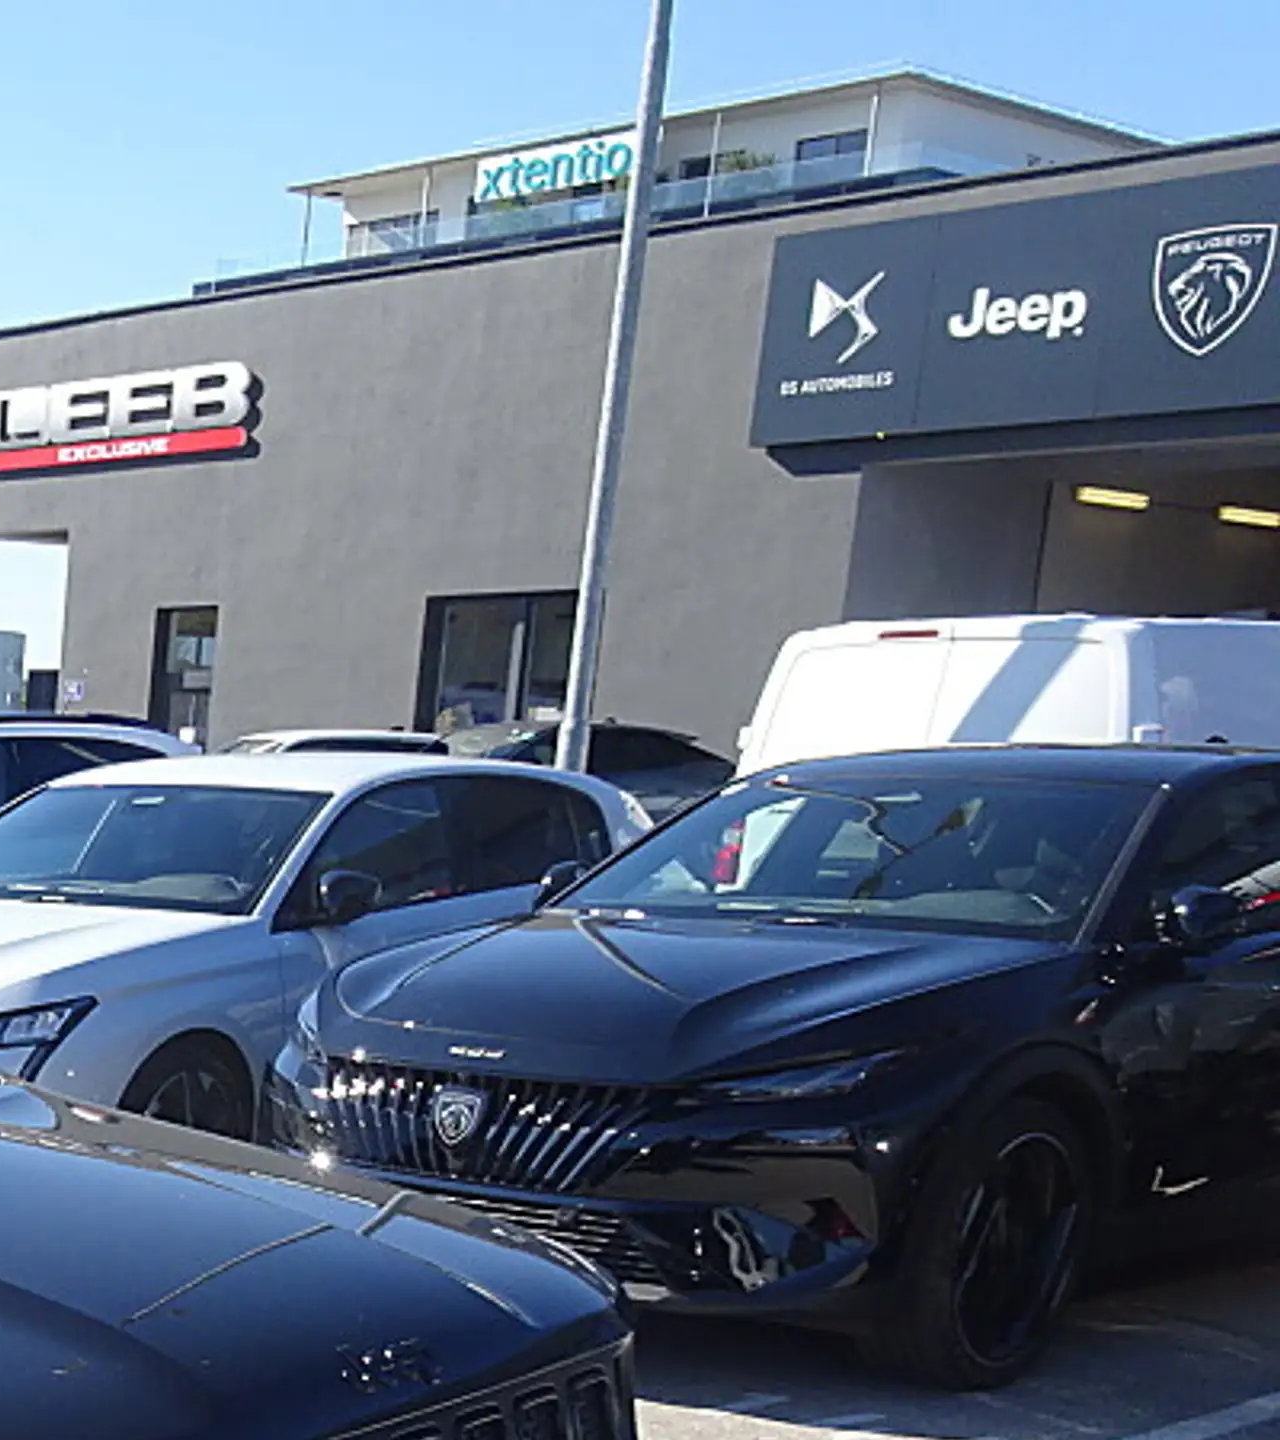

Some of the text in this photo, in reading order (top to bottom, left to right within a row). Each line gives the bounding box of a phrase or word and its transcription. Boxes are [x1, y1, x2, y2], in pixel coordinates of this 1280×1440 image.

[480, 140, 634, 199] xtentio
[1166, 232, 1267, 258] PEUGEOT
[948, 287, 1088, 338] Jeep
[800, 370, 895, 395] AUTOMOBILES
[57, 438, 170, 463] EXCLUSIVE
